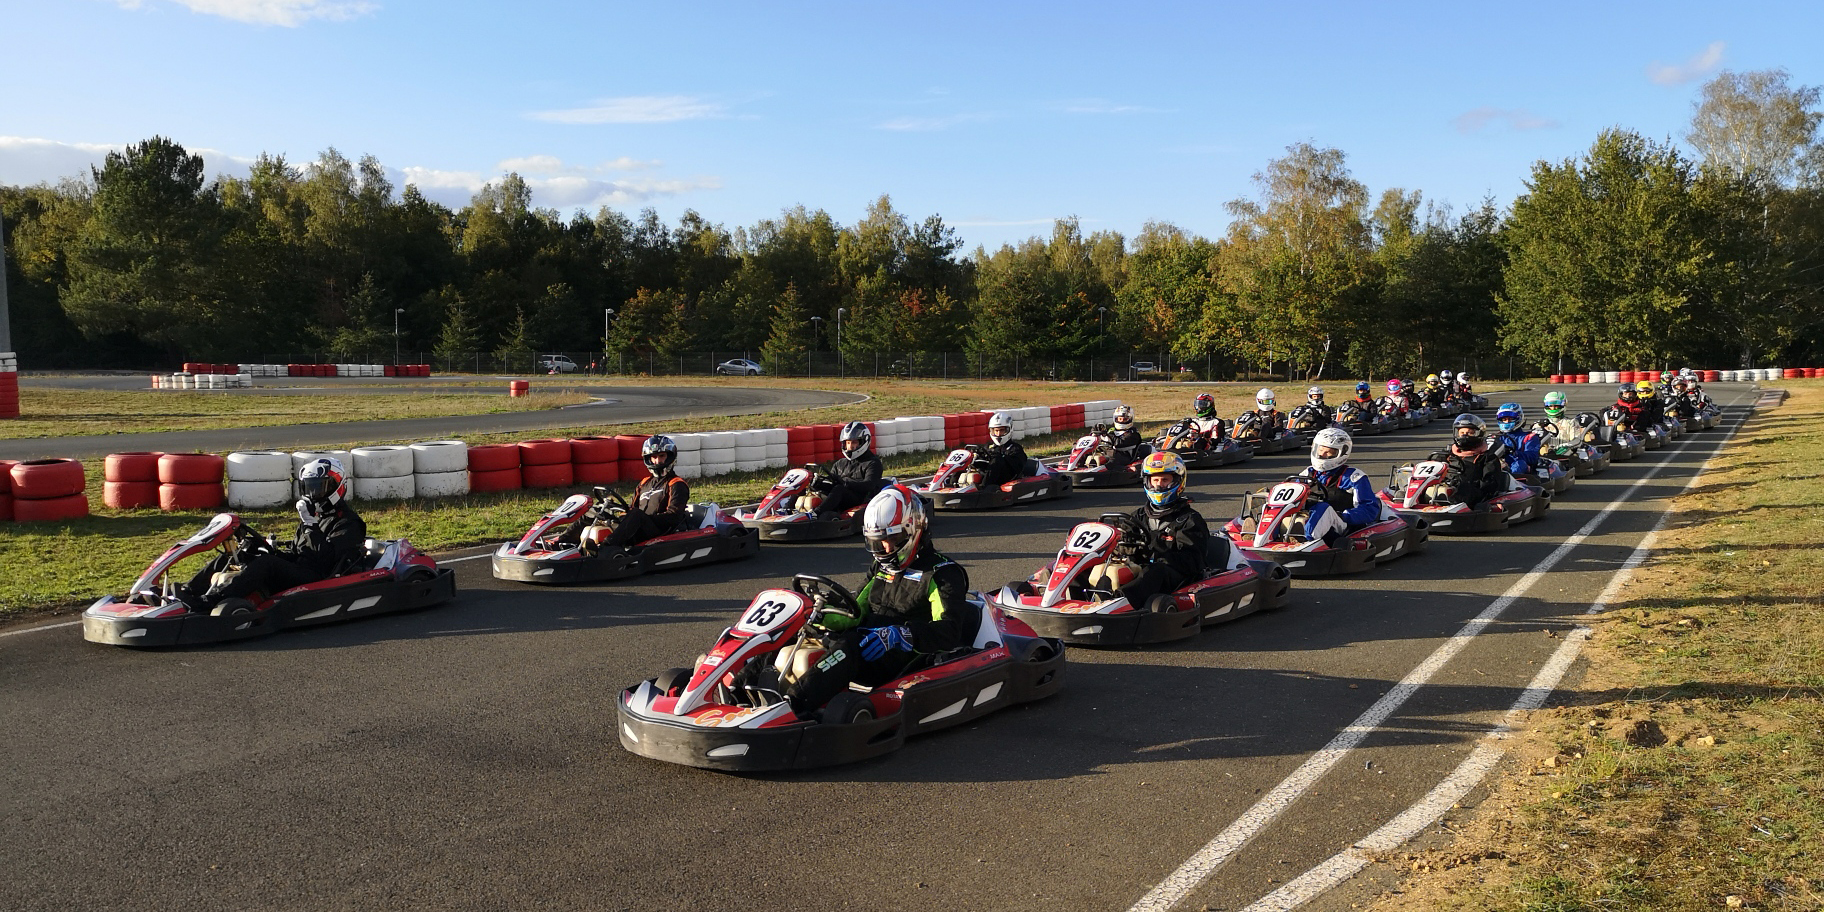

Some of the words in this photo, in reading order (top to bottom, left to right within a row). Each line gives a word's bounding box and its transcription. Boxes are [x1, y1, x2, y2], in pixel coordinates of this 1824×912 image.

[950, 453, 964, 461] 66
[1418, 465, 1435, 475] 74
[782, 474, 800, 484] 64
[1273, 488, 1294, 501] 60
[1073, 530, 1101, 549] 62
[745, 600, 787, 627] 63
[816, 649, 847, 673] SEB
